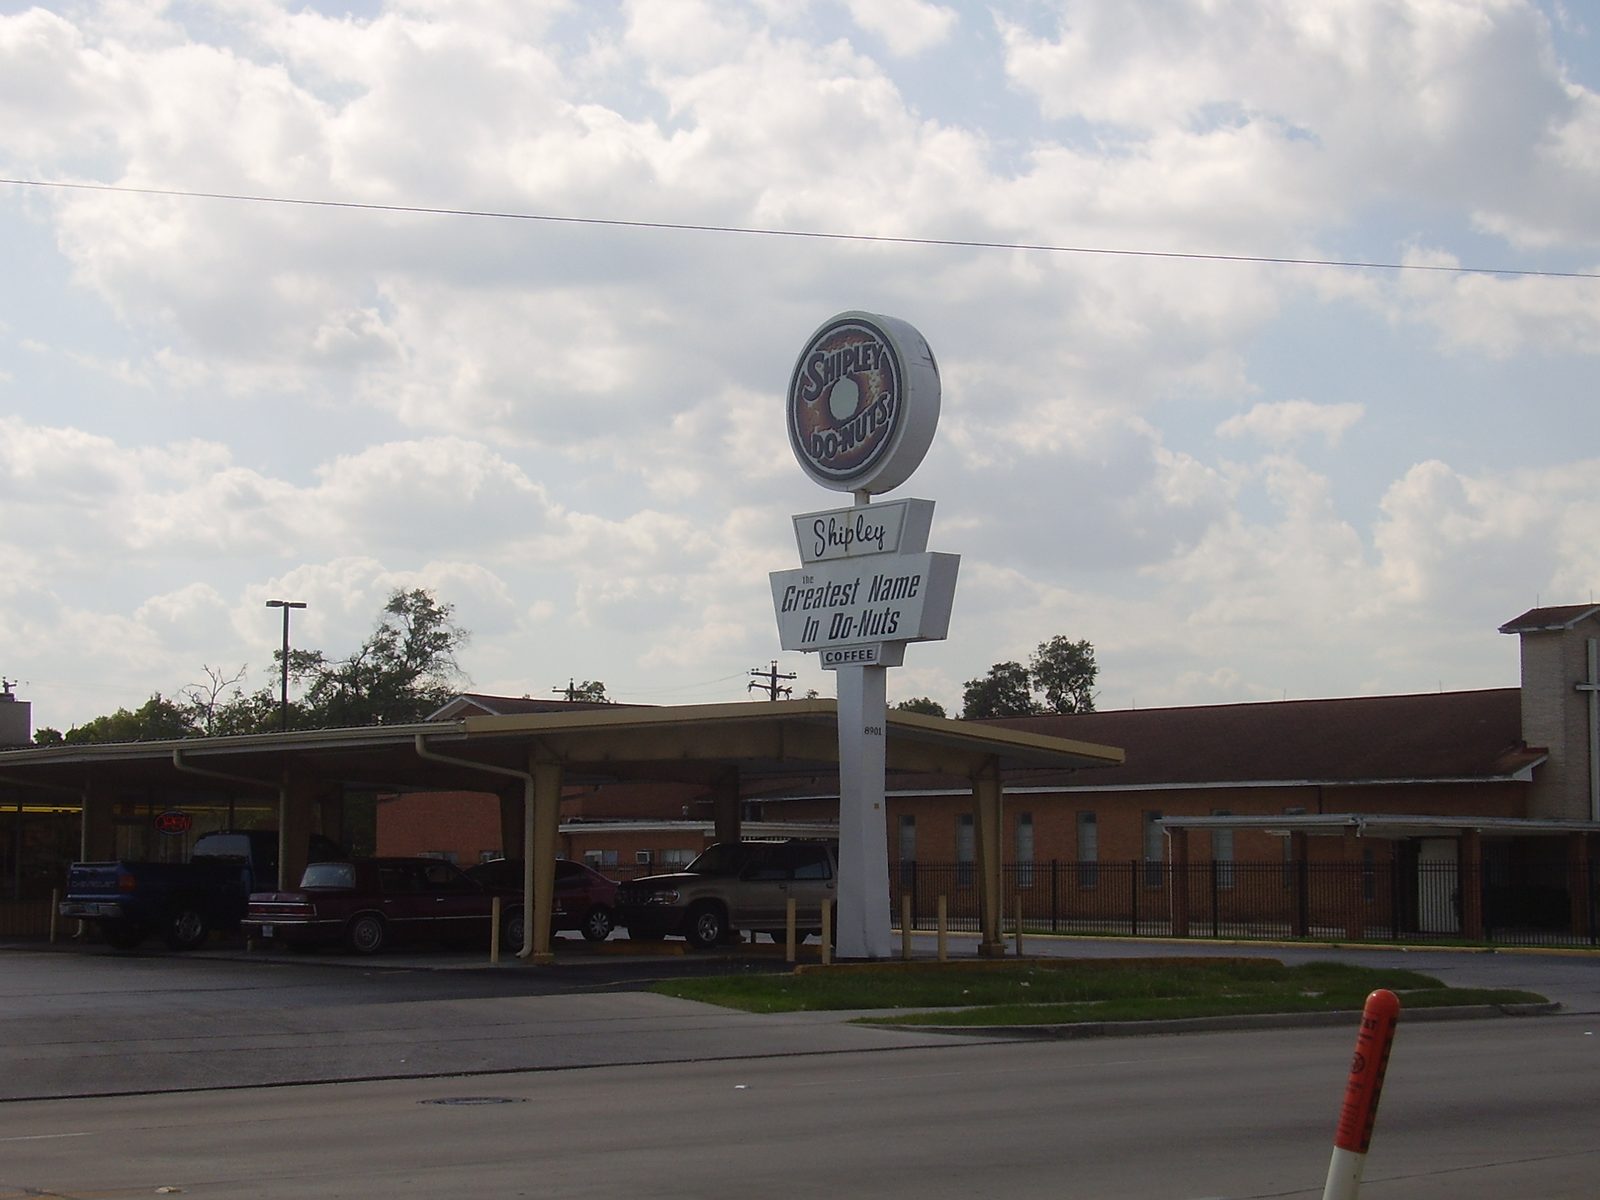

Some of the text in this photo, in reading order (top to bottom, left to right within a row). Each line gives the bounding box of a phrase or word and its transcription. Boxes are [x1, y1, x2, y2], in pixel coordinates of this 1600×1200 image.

[804, 343, 884, 401] SHIPLEY
[811, 394, 889, 459] DO-NUTS
[814, 514, 886, 557] Shipley
[781, 574, 921, 613] Greatest Name
[801, 607, 900, 643] In Do-Nuts
[825, 650, 873, 662] COFFEE
[864, 726, 882, 736] 8901
